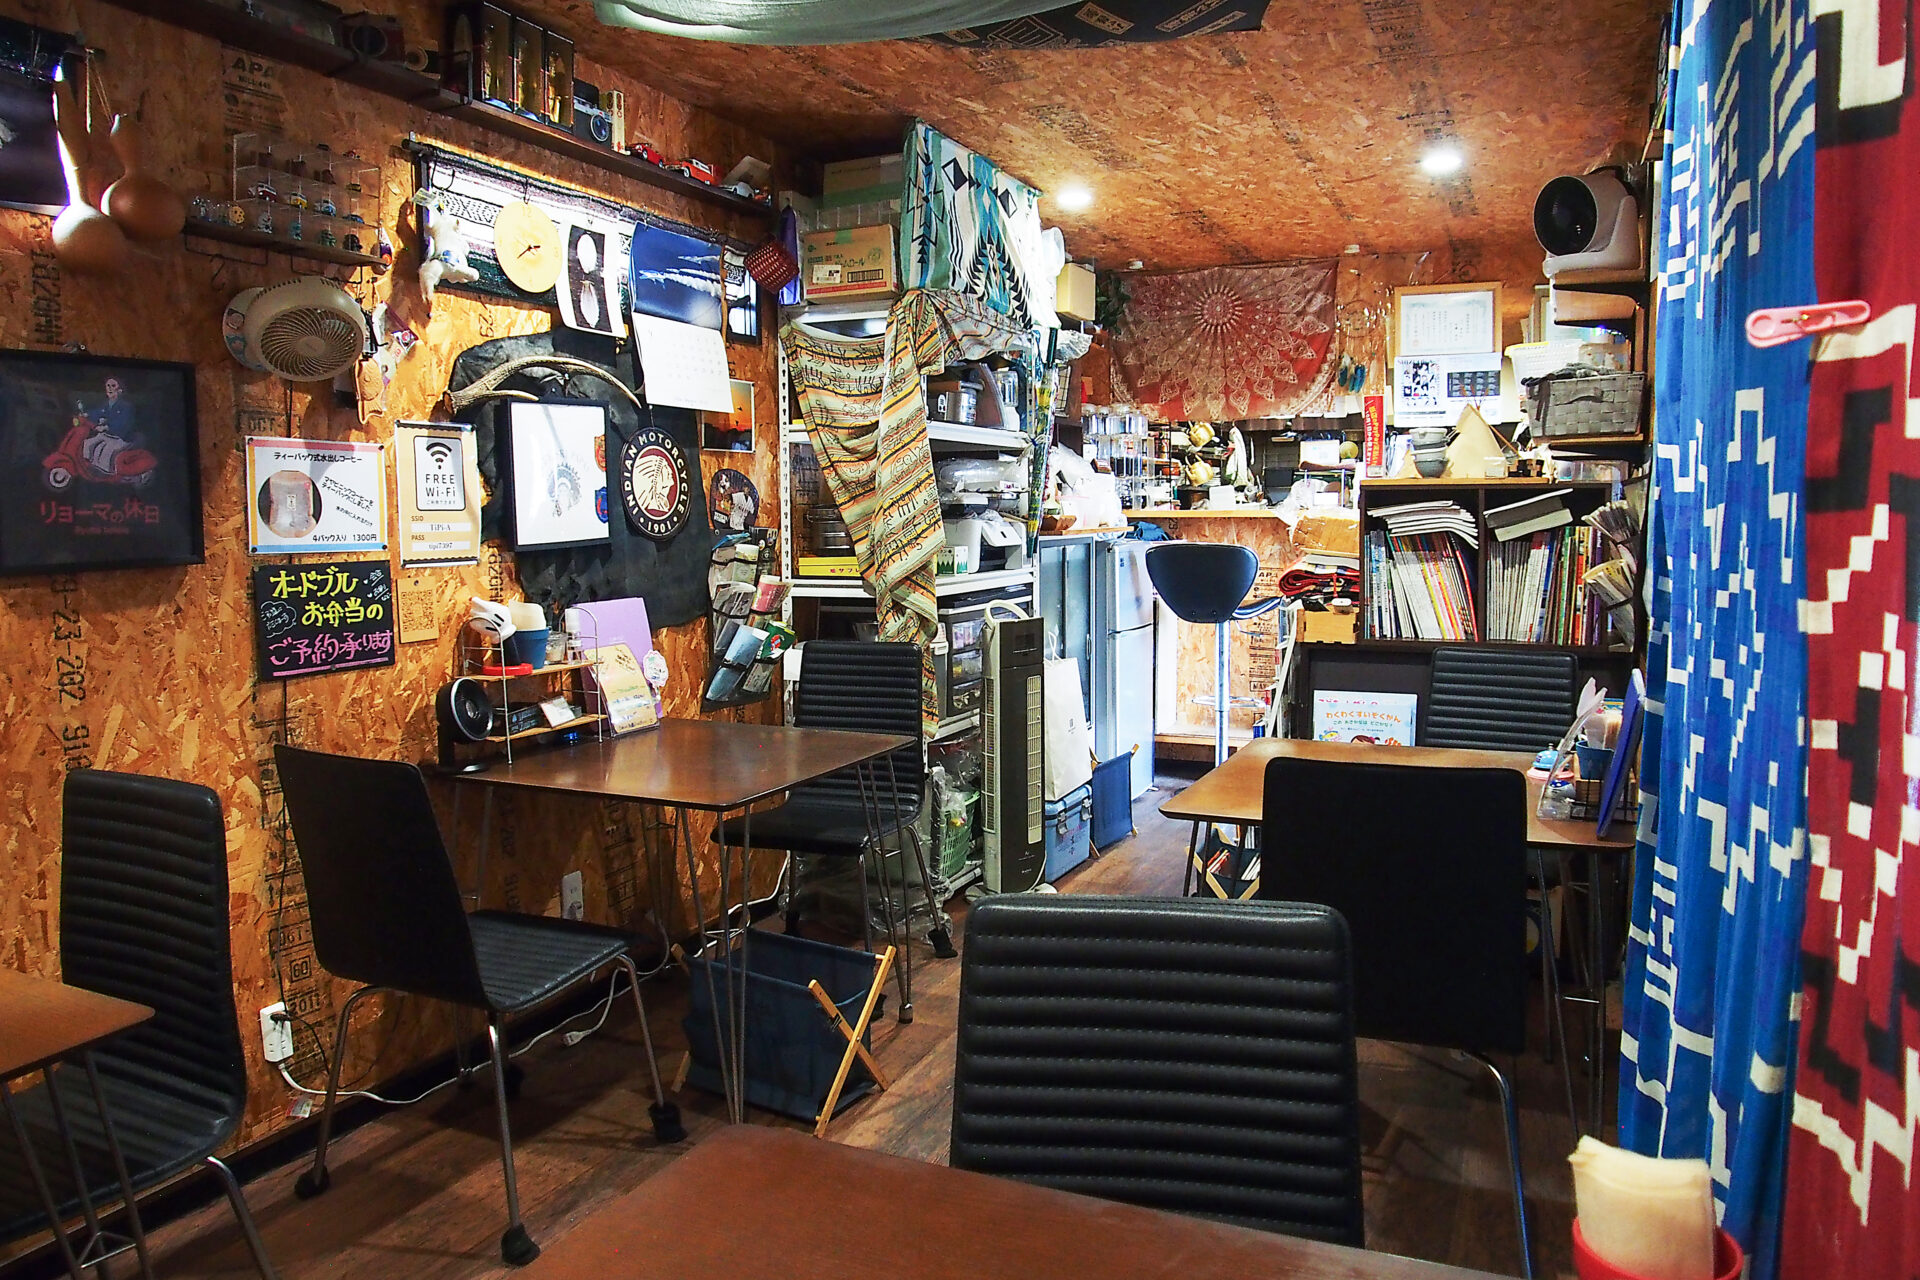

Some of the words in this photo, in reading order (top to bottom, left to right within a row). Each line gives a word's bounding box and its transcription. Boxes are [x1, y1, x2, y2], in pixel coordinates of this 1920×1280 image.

[425, 473, 455, 485] FREE
[623, 444, 639, 515] INDIAN
[637, 431, 689, 514] MOTORCYCLE
[425, 486, 456, 497] Wi-Fi
[41, 498, 160, 524] リョーマの休日
[353, 533, 377, 542] 1300円
[647, 521, 672, 533] 1901
[269, 566, 359, 599] オードブル
[301, 597, 384, 628] お弁当の
[268, 629, 393, 666] ご予約承ります
